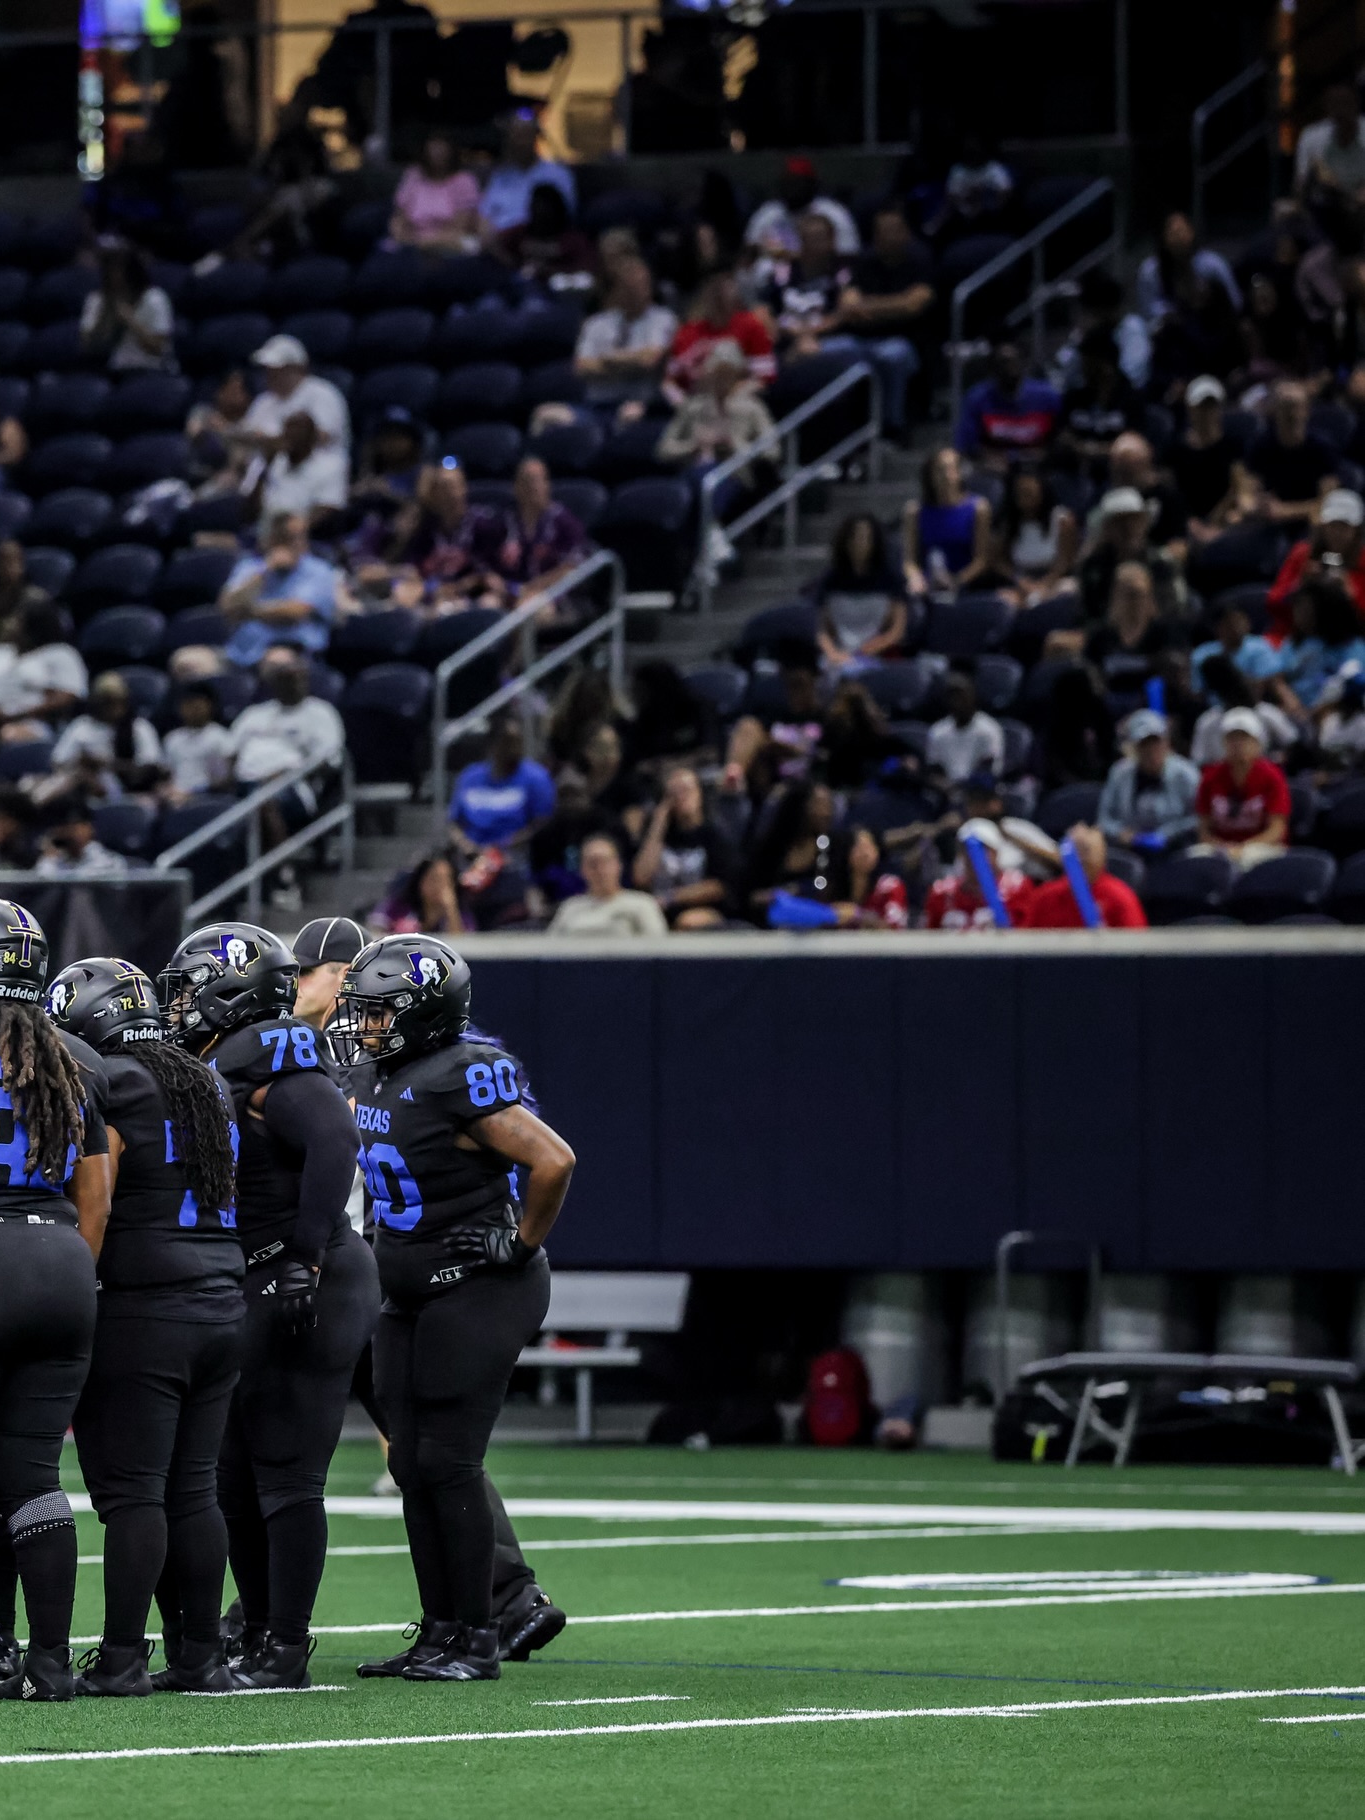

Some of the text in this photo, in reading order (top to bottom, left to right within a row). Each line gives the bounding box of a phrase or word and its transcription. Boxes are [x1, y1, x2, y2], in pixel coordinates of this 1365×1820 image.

[2, 951, 17, 965] 84
[120, 997, 134, 1011] 72
[259, 1026, 319, 1072] 78
[465, 1058, 519, 1107] 80
